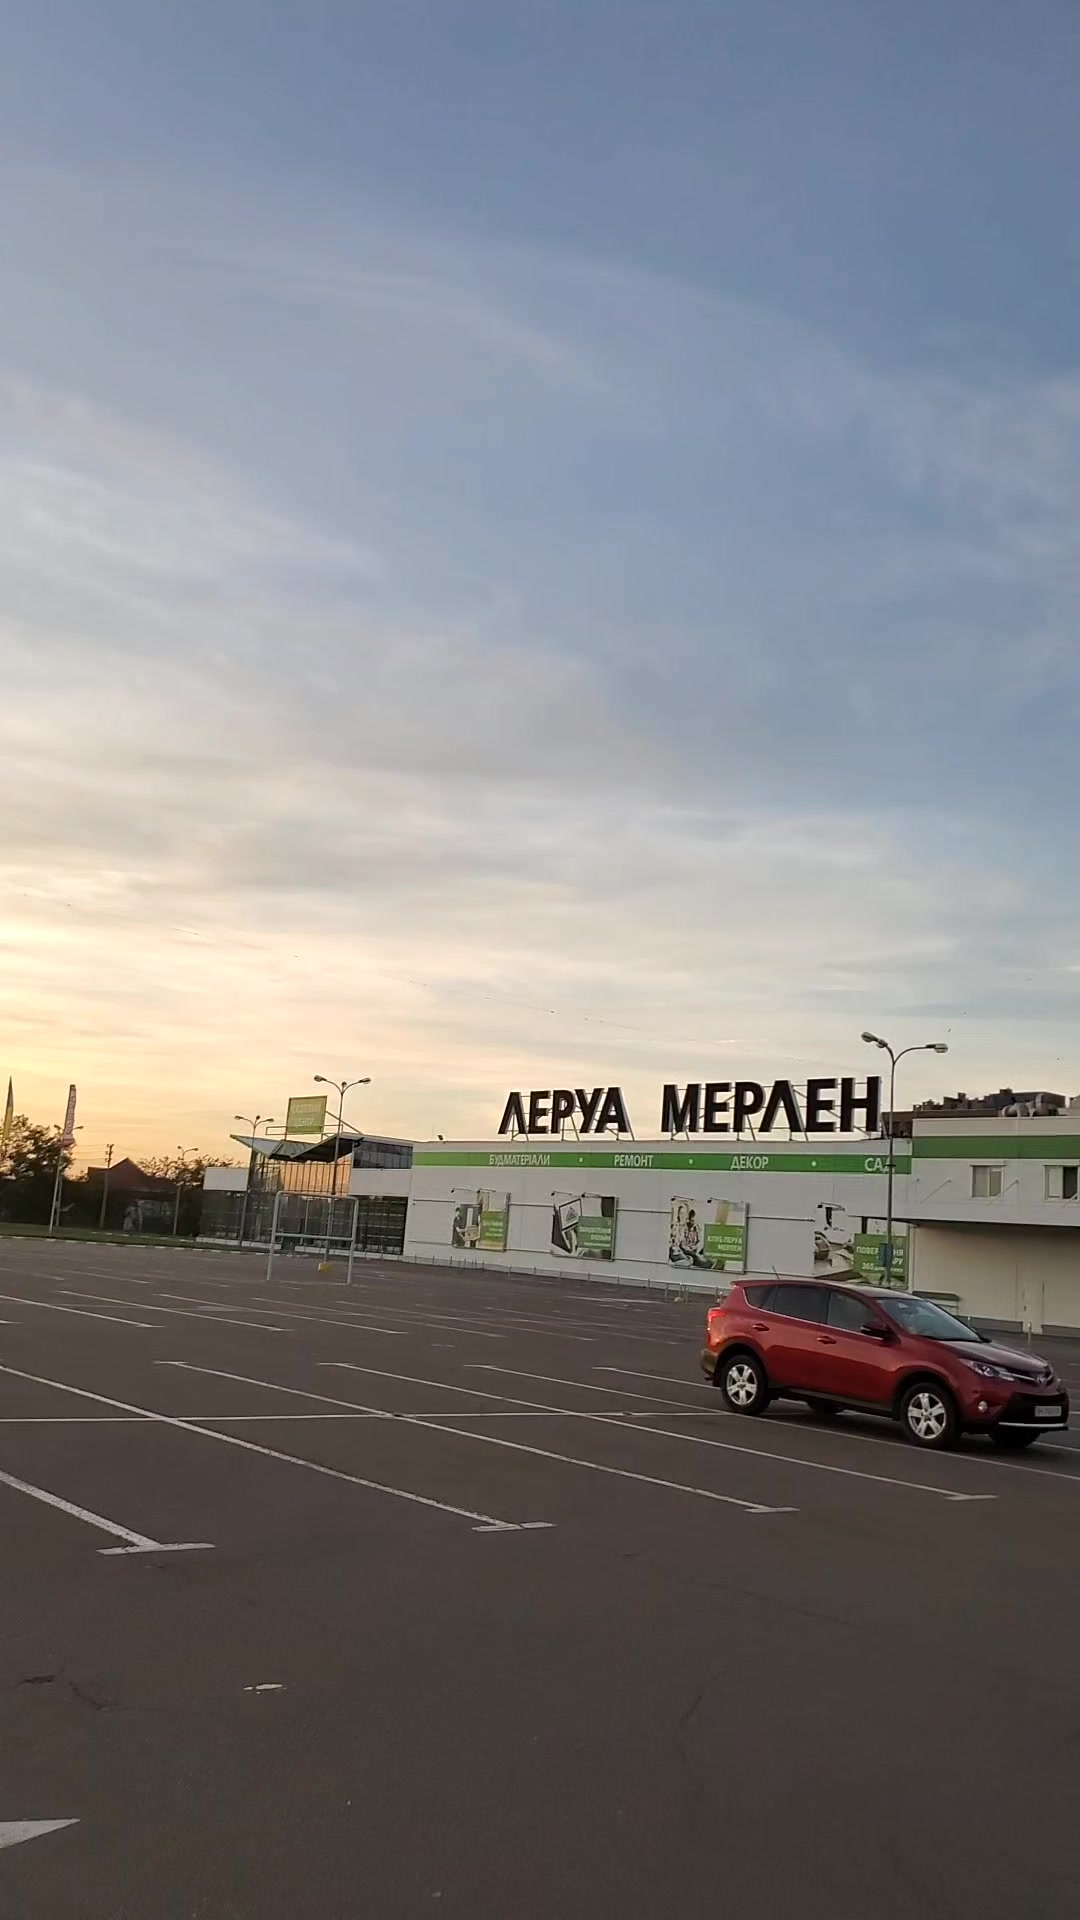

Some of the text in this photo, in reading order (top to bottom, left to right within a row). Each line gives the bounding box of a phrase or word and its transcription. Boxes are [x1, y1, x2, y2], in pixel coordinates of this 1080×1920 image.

[497, 1075, 882, 1135] ЛЕРУА МЕРЛЕН
[488, 1154, 550, 1167] БУДМАТЕРІАЛИ
[614, 1154, 654, 1167] РЕМОНТ
[730, 1156, 769, 1171] ДЕКОР
